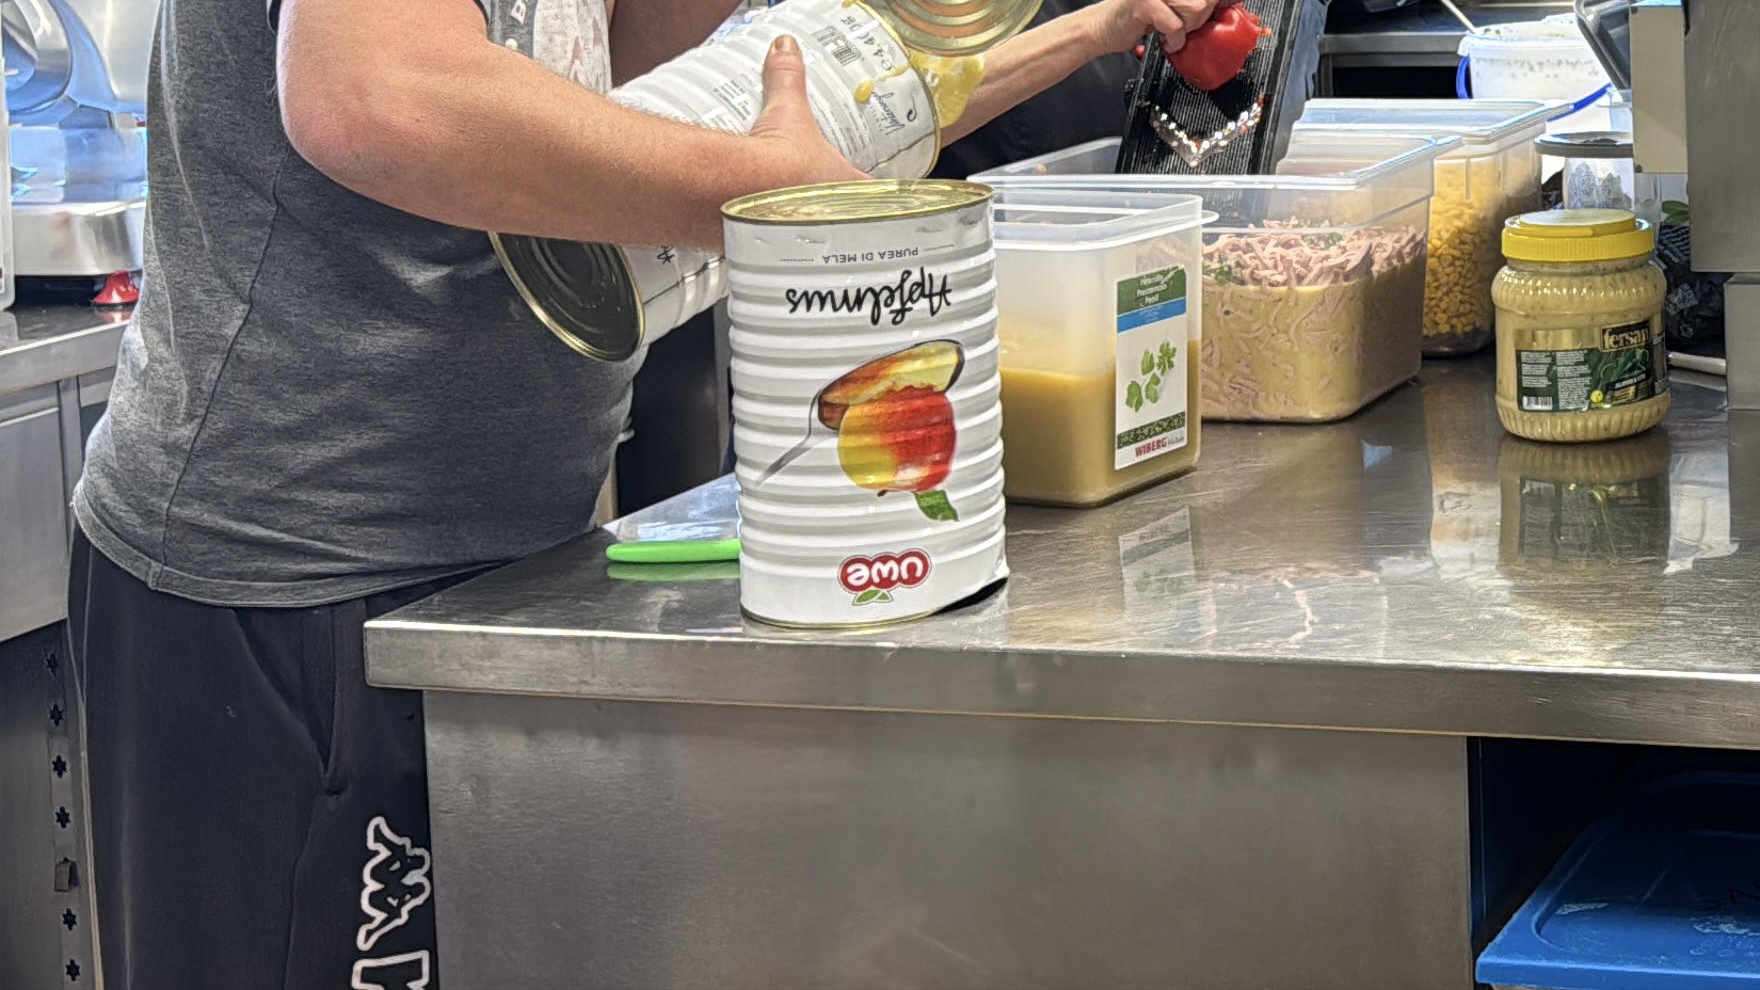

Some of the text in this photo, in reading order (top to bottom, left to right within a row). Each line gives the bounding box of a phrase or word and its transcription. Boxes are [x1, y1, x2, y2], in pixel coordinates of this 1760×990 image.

[822, 247, 919, 264] PUREA DI MELA
[785, 266, 953, 326] Apfelmus
[1135, 436, 1168, 458] WIBERG
